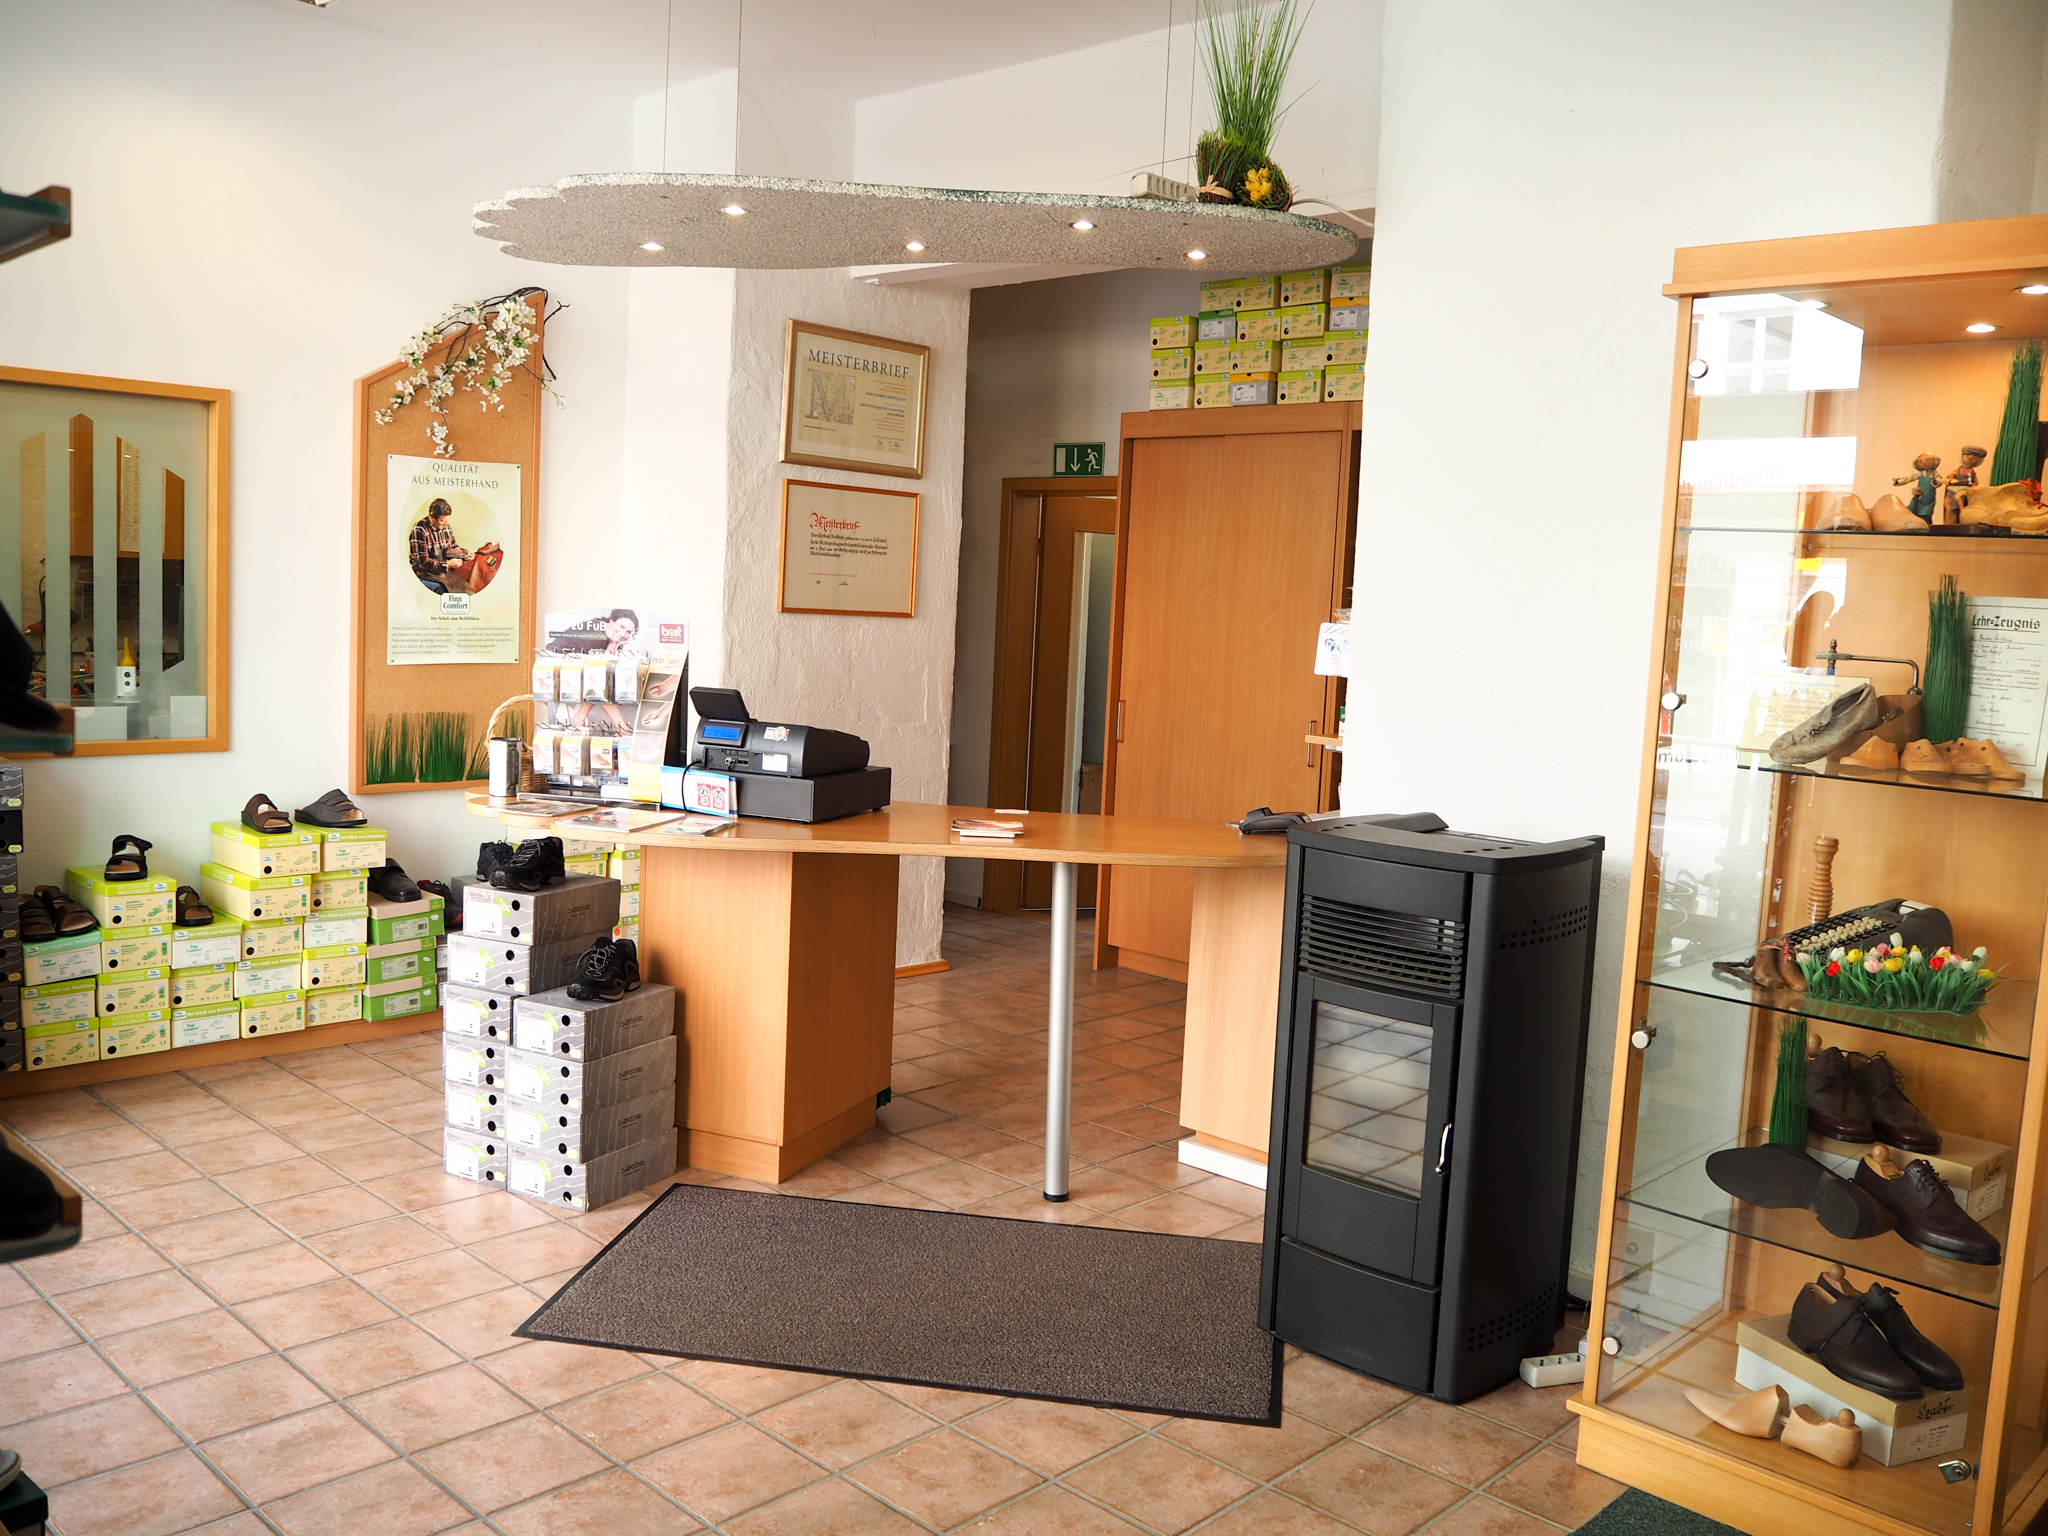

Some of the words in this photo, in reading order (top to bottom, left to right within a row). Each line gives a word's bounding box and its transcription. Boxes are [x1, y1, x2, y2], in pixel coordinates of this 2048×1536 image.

[808, 349, 909, 378] MEISTERBRIEF
[432, 463, 479, 474] QUALITÄT
[411, 475, 430, 485] AUS
[433, 477, 499, 489] MEISTERHAND
[448, 594, 462, 602] Finn
